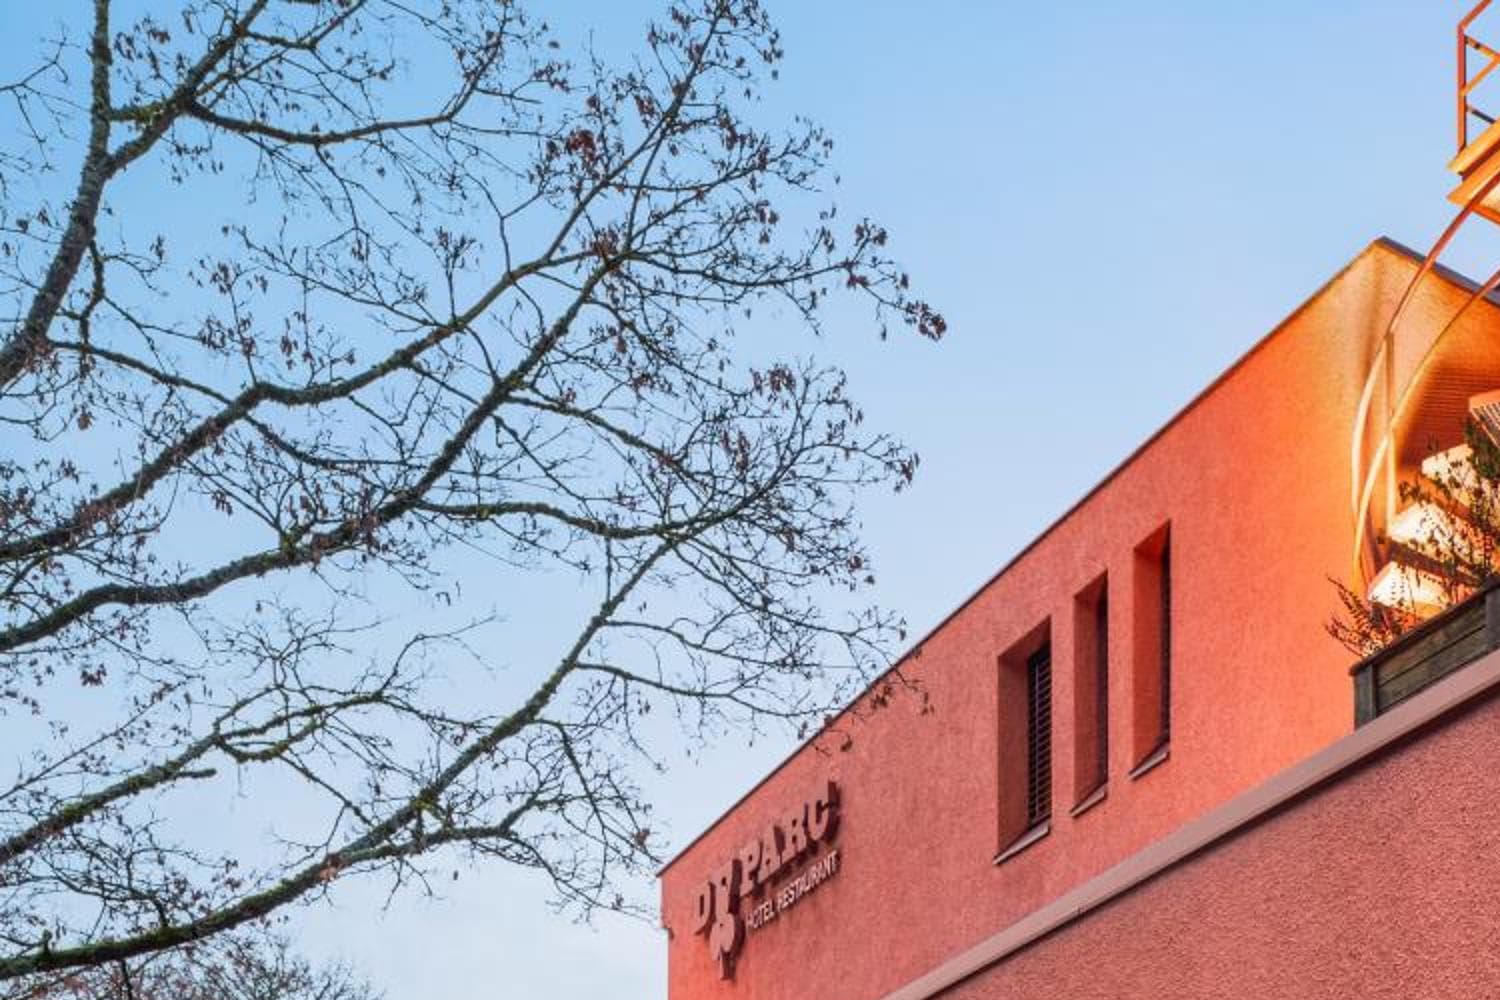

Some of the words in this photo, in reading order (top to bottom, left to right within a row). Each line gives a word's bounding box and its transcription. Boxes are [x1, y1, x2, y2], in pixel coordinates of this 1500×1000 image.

[738, 779, 842, 898] PARC
[746, 896, 776, 931] HOTEL
[777, 850, 842, 912] RESTAURANT
